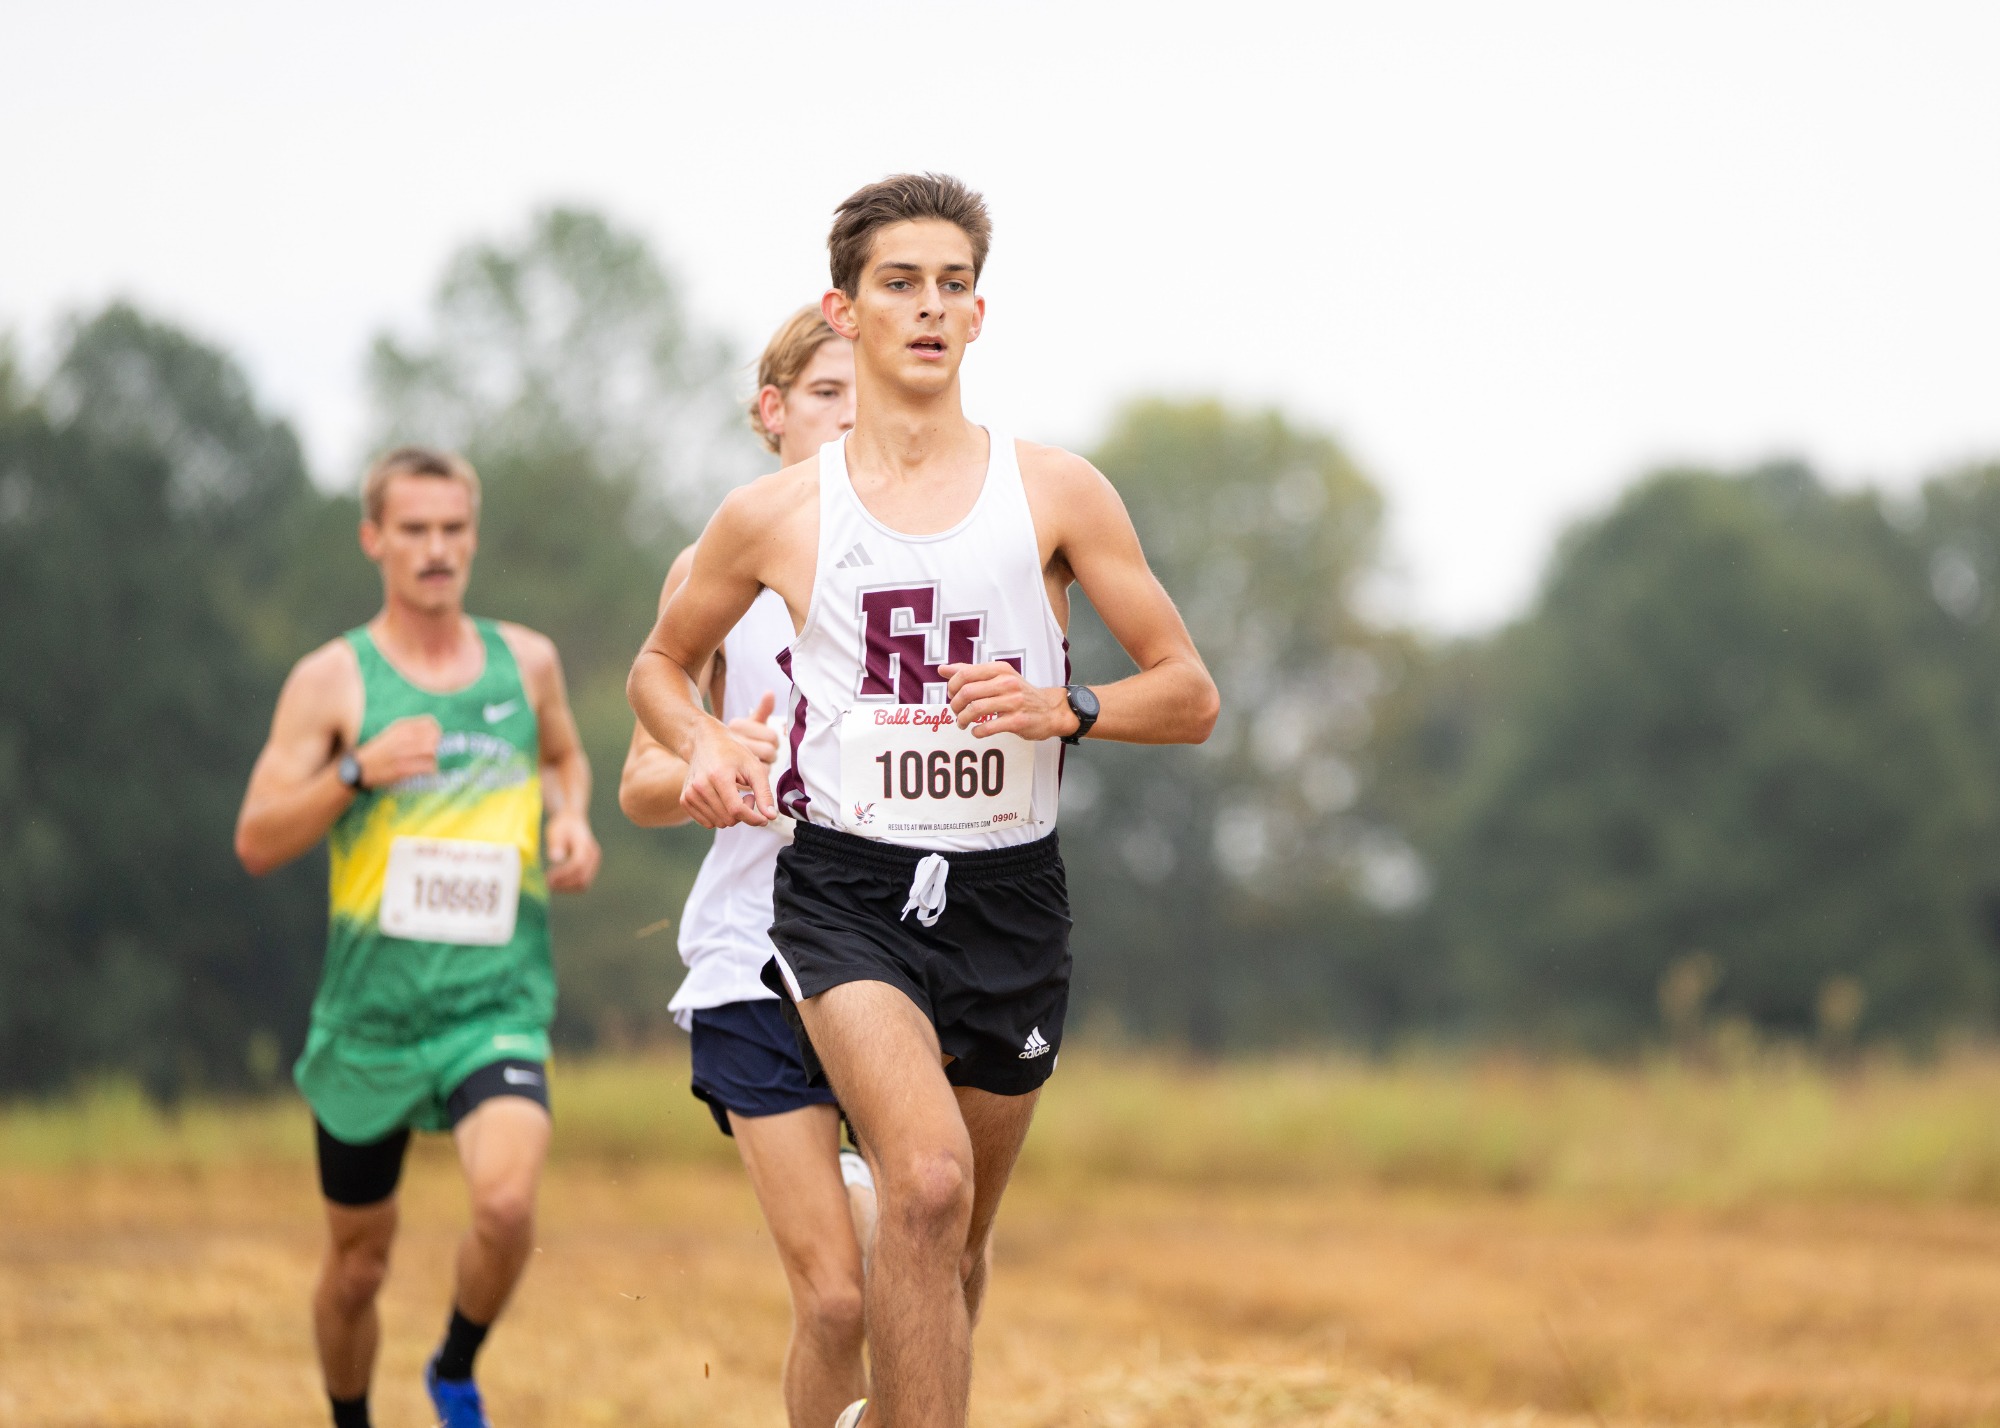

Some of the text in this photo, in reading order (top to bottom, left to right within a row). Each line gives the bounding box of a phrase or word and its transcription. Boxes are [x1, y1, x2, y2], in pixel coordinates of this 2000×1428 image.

[873, 707, 910, 726] Bald
[912, 707, 955, 733] Eagle
[875, 748, 1005, 799] 10660
[887, 820, 991, 831] RESULTS AT WWW.BALDEAGLEEVENTS.COM
[1018, 1044, 1051, 1059] adidas
